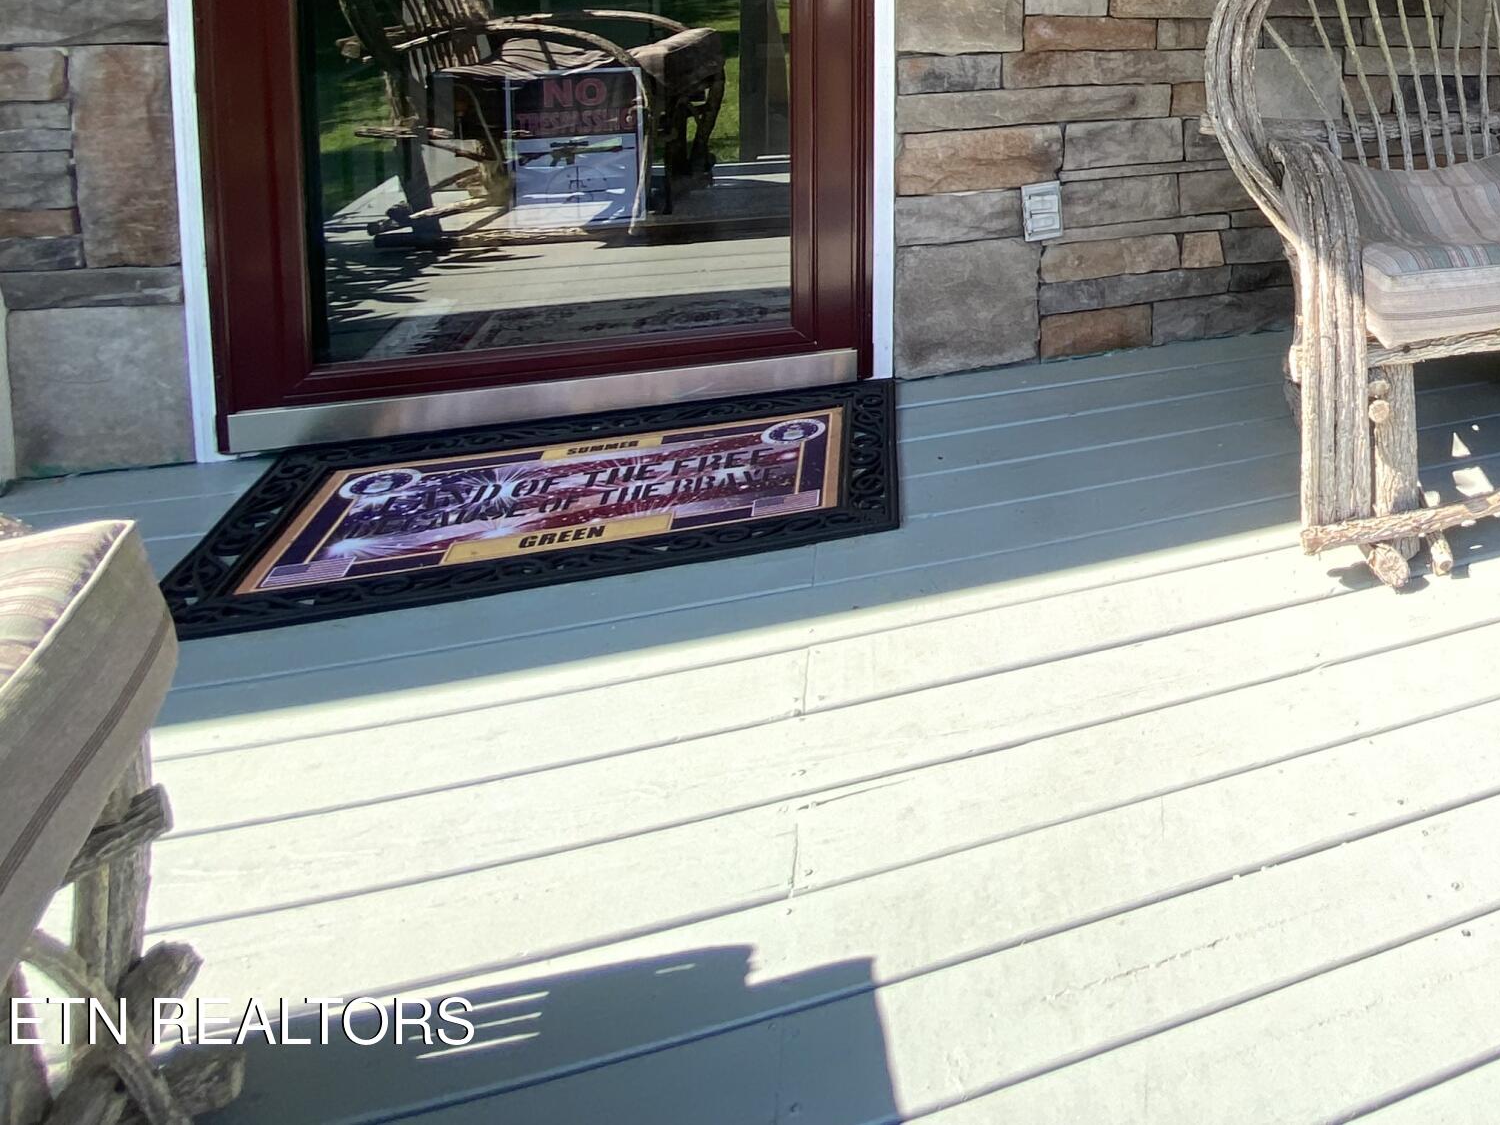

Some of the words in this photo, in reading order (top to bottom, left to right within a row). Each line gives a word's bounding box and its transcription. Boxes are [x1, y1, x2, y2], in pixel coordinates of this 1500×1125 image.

[543, 77, 608, 107] NO
[567, 439, 639, 456] SUMMER
[511, 474, 570, 497] OF
[580, 462, 663, 487] THE
[671, 447, 774, 476] FREE
[538, 494, 581, 514] OF
[599, 481, 666, 505] THE
[671, 465, 782, 494] BRAVE
[518, 525, 606, 549] GREEN
